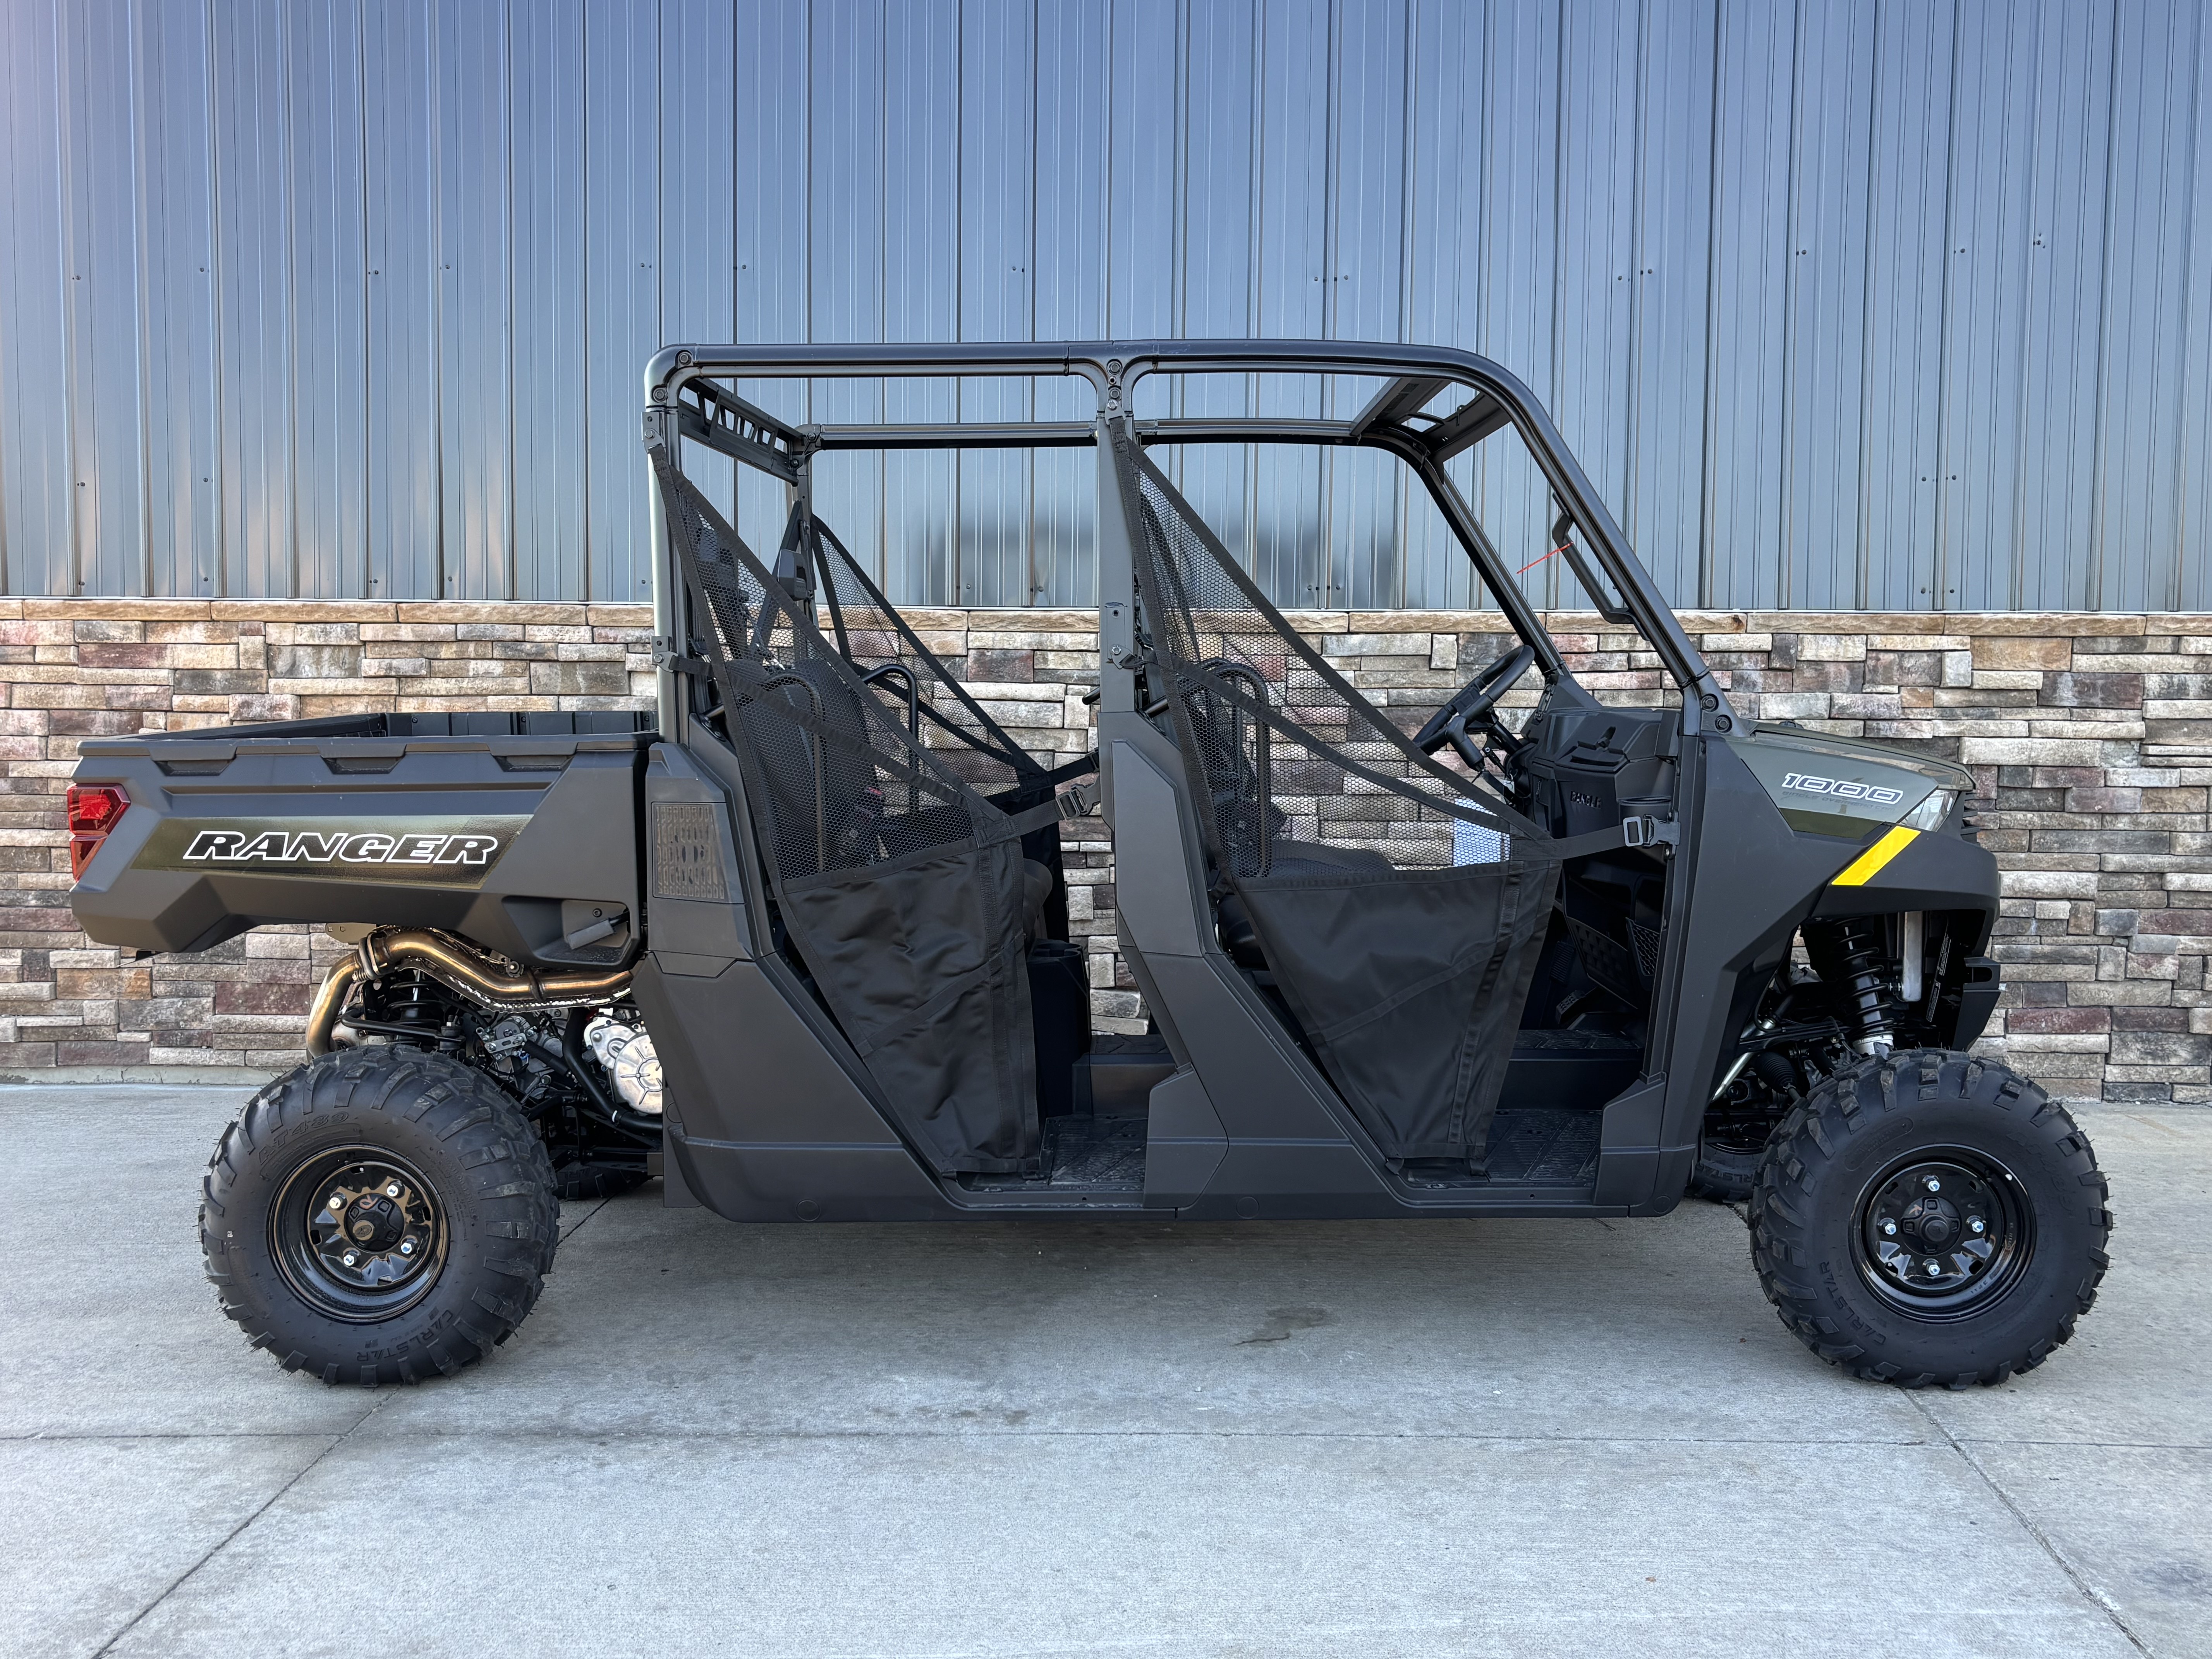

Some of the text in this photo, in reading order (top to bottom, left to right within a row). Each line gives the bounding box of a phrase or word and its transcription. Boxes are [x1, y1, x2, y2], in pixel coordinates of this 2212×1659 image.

[1781, 773, 1903, 805] 1000
[182, 830, 498, 864] RANGER
[357, 1309, 453, 1362] CARLSTAR
